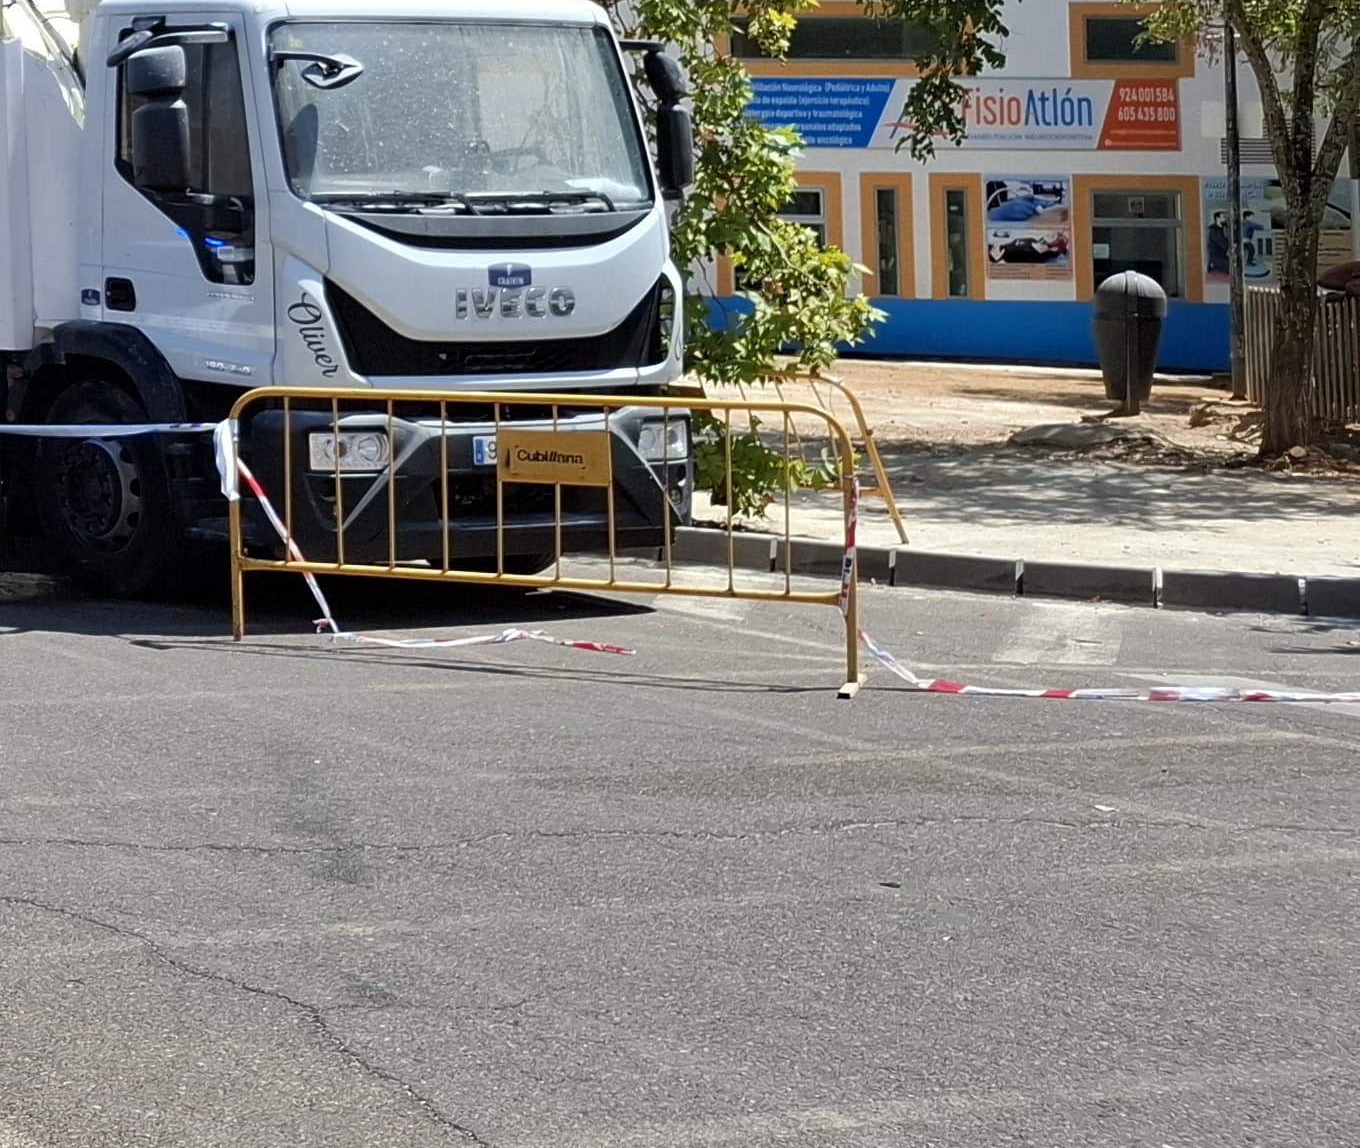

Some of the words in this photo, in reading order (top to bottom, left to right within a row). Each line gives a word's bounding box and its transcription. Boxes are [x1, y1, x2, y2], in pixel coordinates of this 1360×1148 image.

[1119, 87, 1137, 102] 924
[1138, 87, 1154, 102] 001
[1155, 87, 1174, 102] 584
[1118, 106, 1135, 121] 605
[1137, 106, 1155, 121] 435
[1157, 106, 1176, 121] 800
[455, 286, 576, 320] IVECO
[286, 292, 339, 379] Oliver
